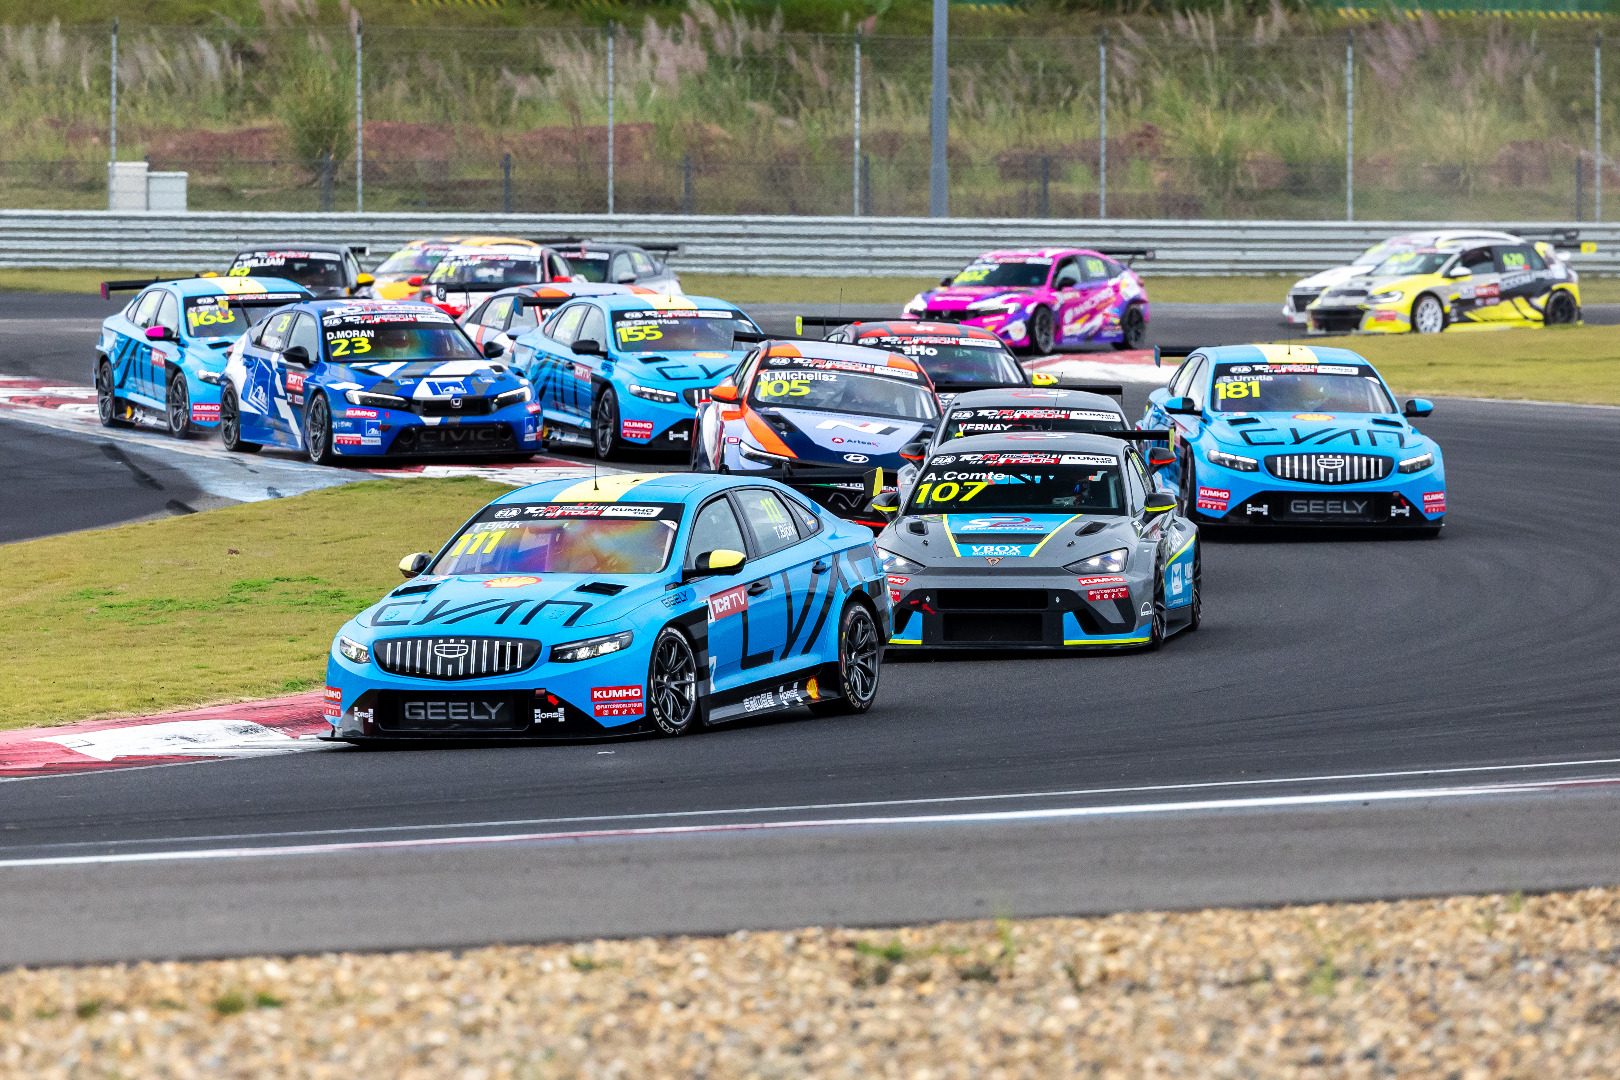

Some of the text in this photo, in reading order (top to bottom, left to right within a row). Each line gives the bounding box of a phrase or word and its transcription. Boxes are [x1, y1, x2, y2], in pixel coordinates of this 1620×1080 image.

[326, 330, 375, 340] D.MORAN
[616, 325, 663, 343] 155
[330, 337, 372, 357] 23
[760, 371, 838, 382] N.Michelisz
[757, 380, 811, 397] 105
[1215, 381, 1260, 400] 181
[420, 429, 495, 443] CIVIC
[923, 471, 1006, 482] A.Comte
[915, 481, 989, 504] 107
[1199, 489, 1229, 499] KUMHO
[1291, 500, 1369, 513] GEELY
[450, 530, 506, 557] 111
[660, 590, 689, 609] GEELY
[593, 688, 641, 699] KUMHO
[404, 701, 505, 721] GEELY
[534, 706, 565, 724] HORSE
